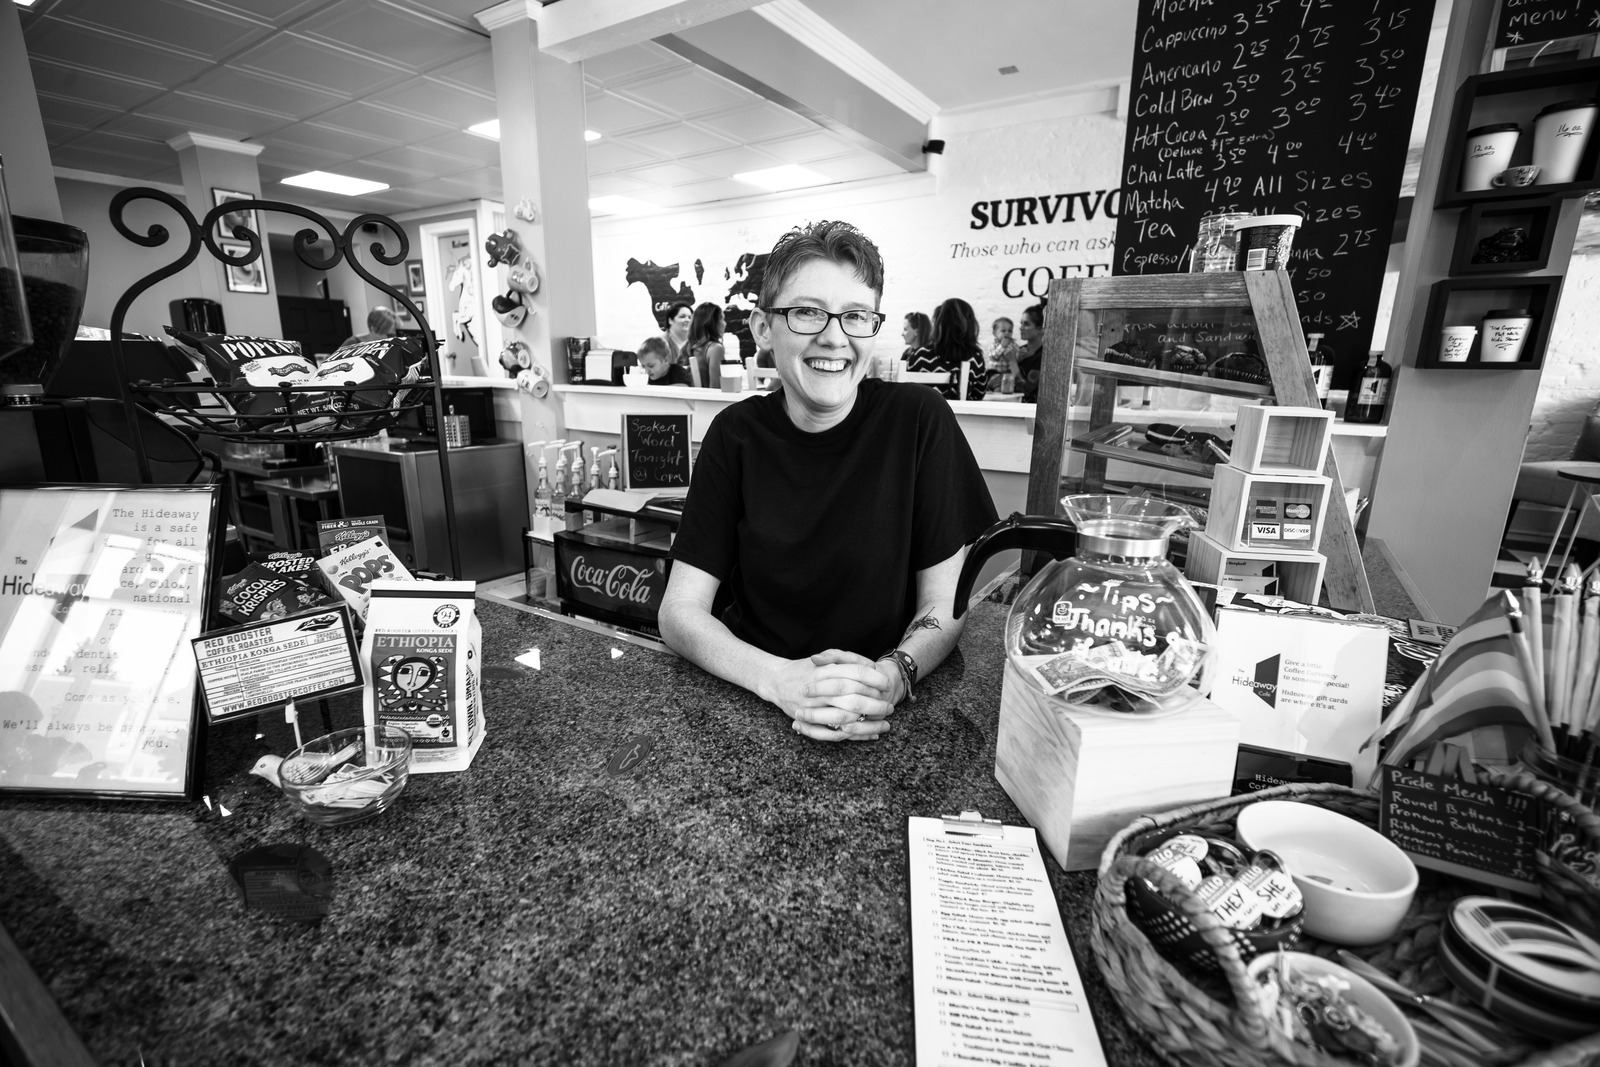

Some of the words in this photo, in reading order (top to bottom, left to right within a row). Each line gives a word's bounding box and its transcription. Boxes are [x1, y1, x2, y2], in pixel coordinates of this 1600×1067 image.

[1142, 25, 1227, 52] Cappuccino
[1140, 61, 1221, 88] Americano
[1135, 93, 1174, 117] Cold
[1181, 89, 1213, 111] Brew
[1132, 123, 1165, 152] Hot
[1165, 121, 1208, 145] Cocoa
[1127, 163, 1162, 185] Chai
[1167, 160, 1205, 180] Latte
[1124, 190, 1184, 216] Matcha
[1253, 176, 1282, 196] All
[1295, 170, 1372, 193] Sizes
[1134, 219, 1175, 243] Tea
[950, 242, 999, 259] Those
[1004, 237, 1041, 255] who
[1046, 239, 1079, 251] can
[631, 418, 680, 438] Spoken
[640, 433, 675, 447] Word
[631, 449, 685, 468] Tonight
[112, 508, 134, 518] The
[141, 508, 200, 520] Hideaway
[134, 522, 147, 532] is
[155, 524, 161, 532] a
[170, 522, 197, 533] safe
[1257, 526, 1276, 534] VISA
[175, 538, 196, 546] all
[15, 557, 27, 565] The
[338, 554, 395, 595] POPS
[133, 594, 191, 603] national
[233, 579, 271, 605] COCOA
[238, 579, 286, 616] KRISPIES
[204, 638, 224, 649] RED
[227, 627, 272, 644] ROOSTER
[1063, 607, 1157, 647] Thanks
[206, 645, 236, 657] COFFEE
[238, 636, 274, 649] ROASTER
[376, 636, 455, 648] ETHIOPIA
[201, 653, 248, 668] ETHIOPIA
[250, 645, 281, 657] KONGA
[283, 639, 306, 650] SEDE
[1284, 666, 1305, 674] Coffee
[1232, 675, 1278, 693] Hideaway
[1281, 689, 1314, 700] Hideaway
[64, 692, 92, 702] Come
[101, 693, 115, 702] as
[222, 678, 345, 713] WWW.REDROOSTERCOFFEE.COM
[1293, 699, 1315, 707] where
[3, 719, 38, 730] We'll
[47, 721, 90, 732] always
[97, 721, 112, 731] be
[142, 739, 169, 750] you.
[1391, 770, 1436, 790] Pride
[1443, 783, 1495, 805] Merch
[1391, 791, 1438, 812] Round
[1446, 803, 1503, 826] Buttons
[1389, 803, 1444, 826] Pronoun
[1450, 817, 1499, 840] Buttons
[1389, 818, 1444, 840] Ribbons
[1391, 829, 1441, 849] Pronoun
[1257, 879, 1287, 902] SHE
[1213, 888, 1245, 921] THEY
